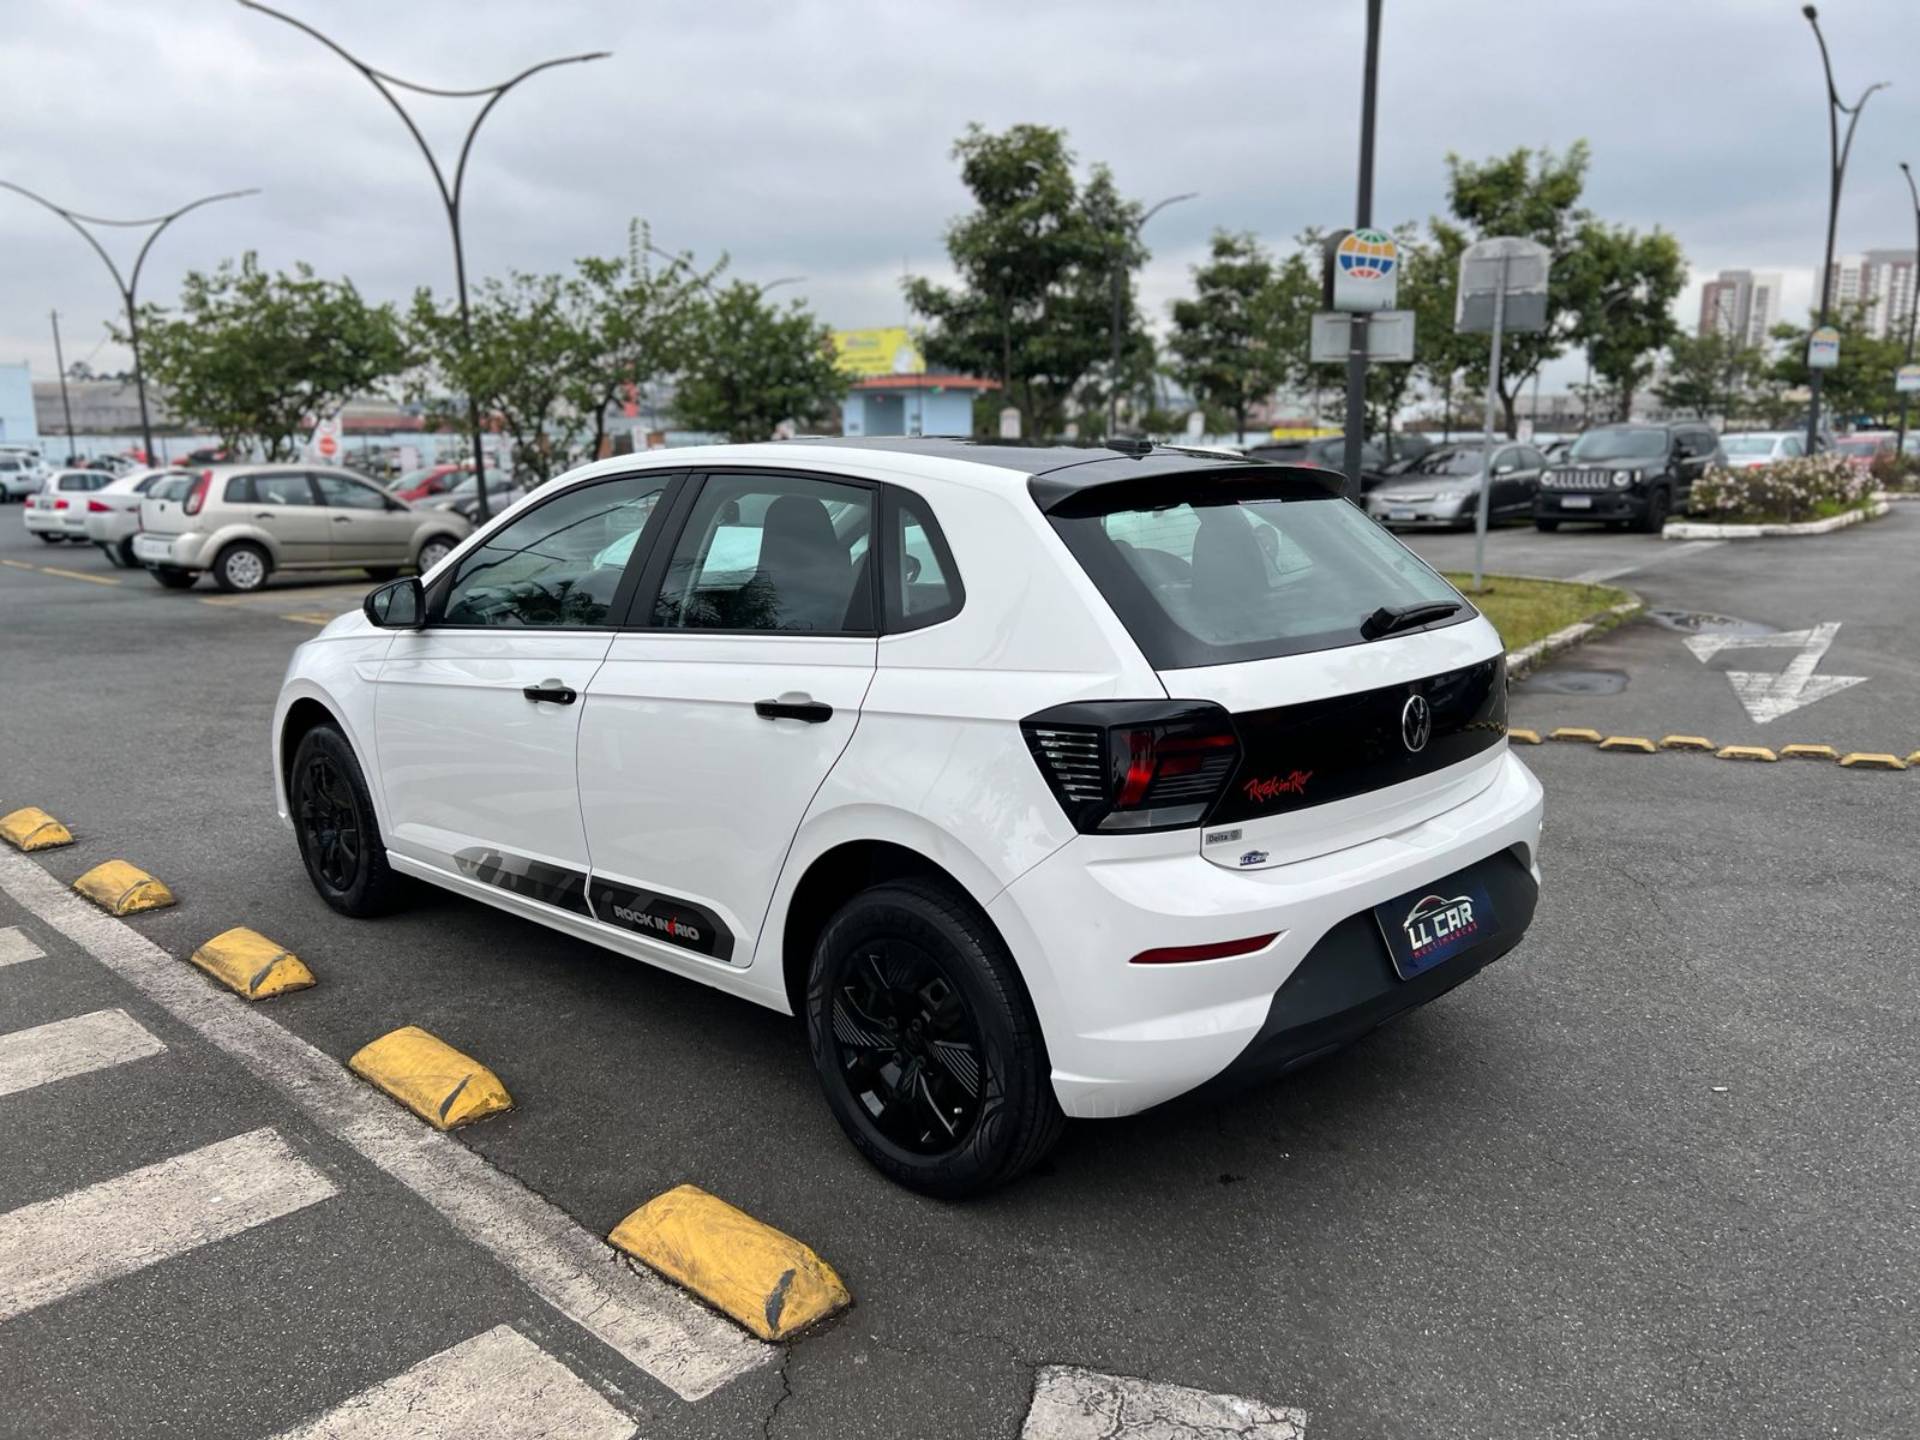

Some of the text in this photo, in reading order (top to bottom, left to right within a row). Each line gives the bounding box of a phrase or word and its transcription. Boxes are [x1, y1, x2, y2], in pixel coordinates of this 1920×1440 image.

[1208, 834, 1228, 842] Delta
[613, 904, 700, 940] ROCK IN RIO
[1408, 902, 1474, 950] LL CAR
